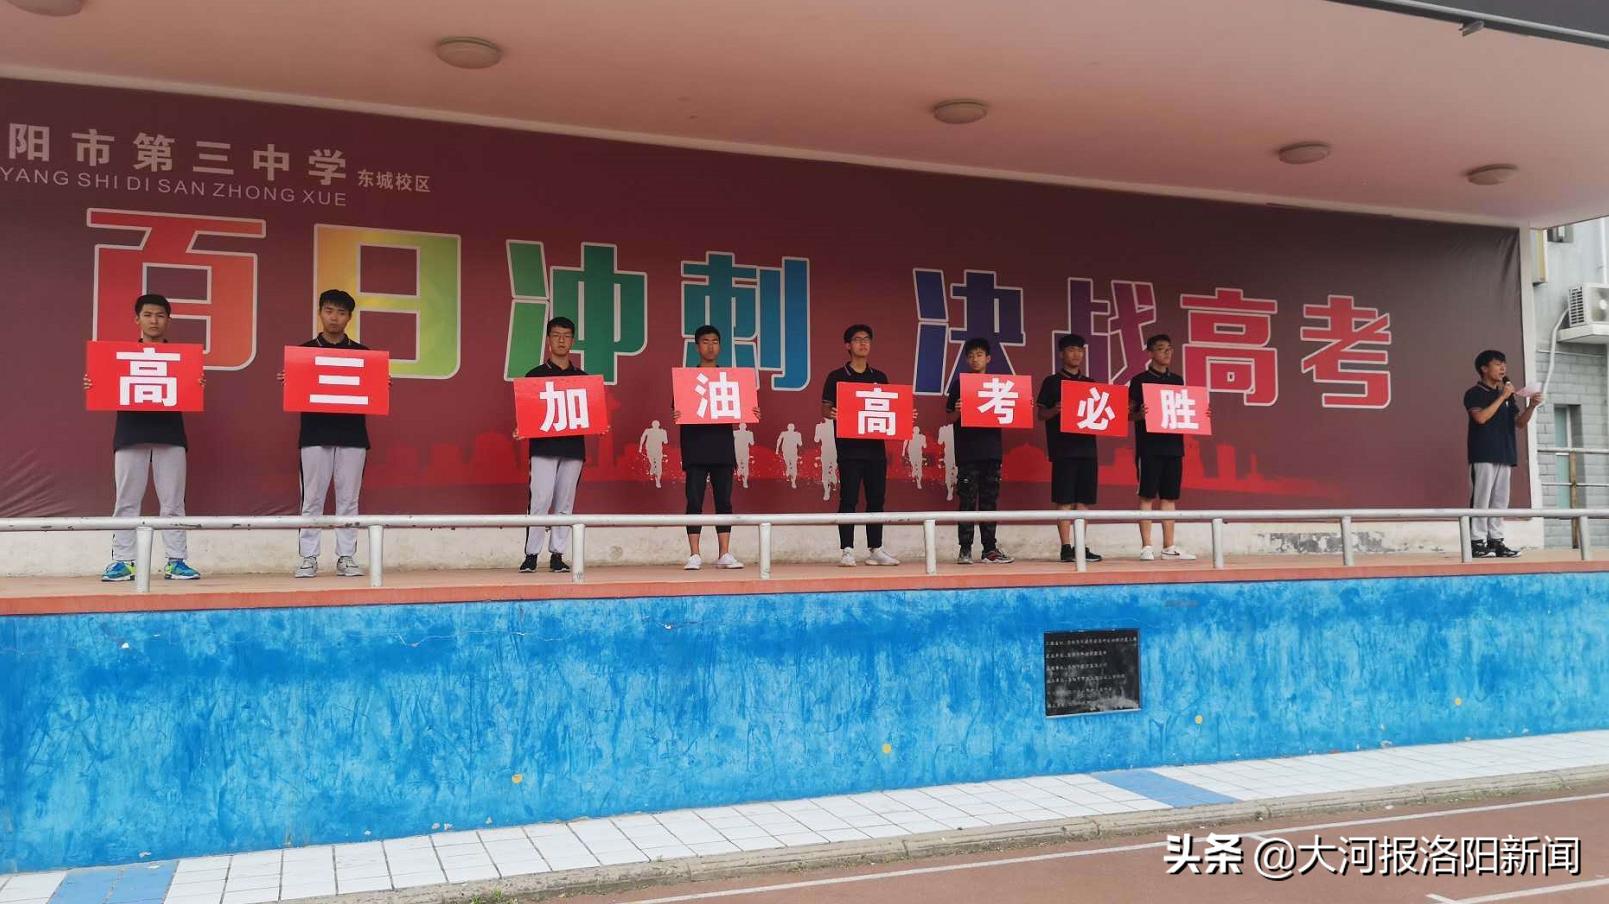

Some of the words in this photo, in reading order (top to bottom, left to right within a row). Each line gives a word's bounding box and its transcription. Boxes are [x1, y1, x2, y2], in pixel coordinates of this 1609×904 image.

[8, 122, 346, 186] 阳市第三中学
[0, 166, 69, 186] YANG
[77, 172, 118, 190] SHI
[127, 176, 149, 192] DI
[158, 178, 205, 197] SAN
[212, 182, 295, 202] ZHONG
[302, 190, 347, 207] XUE
[357, 168, 431, 193] 东城校区
[116, 347, 180, 407] 高
[309, 356, 369, 406] 三
[695, 371, 741, 419] 油
[977, 377, 1019, 424] 考
[539, 381, 589, 432] 加
[856, 388, 899, 436] 高
[1077, 387, 1115, 430] 必
[1160, 388, 1200, 430] 胜
